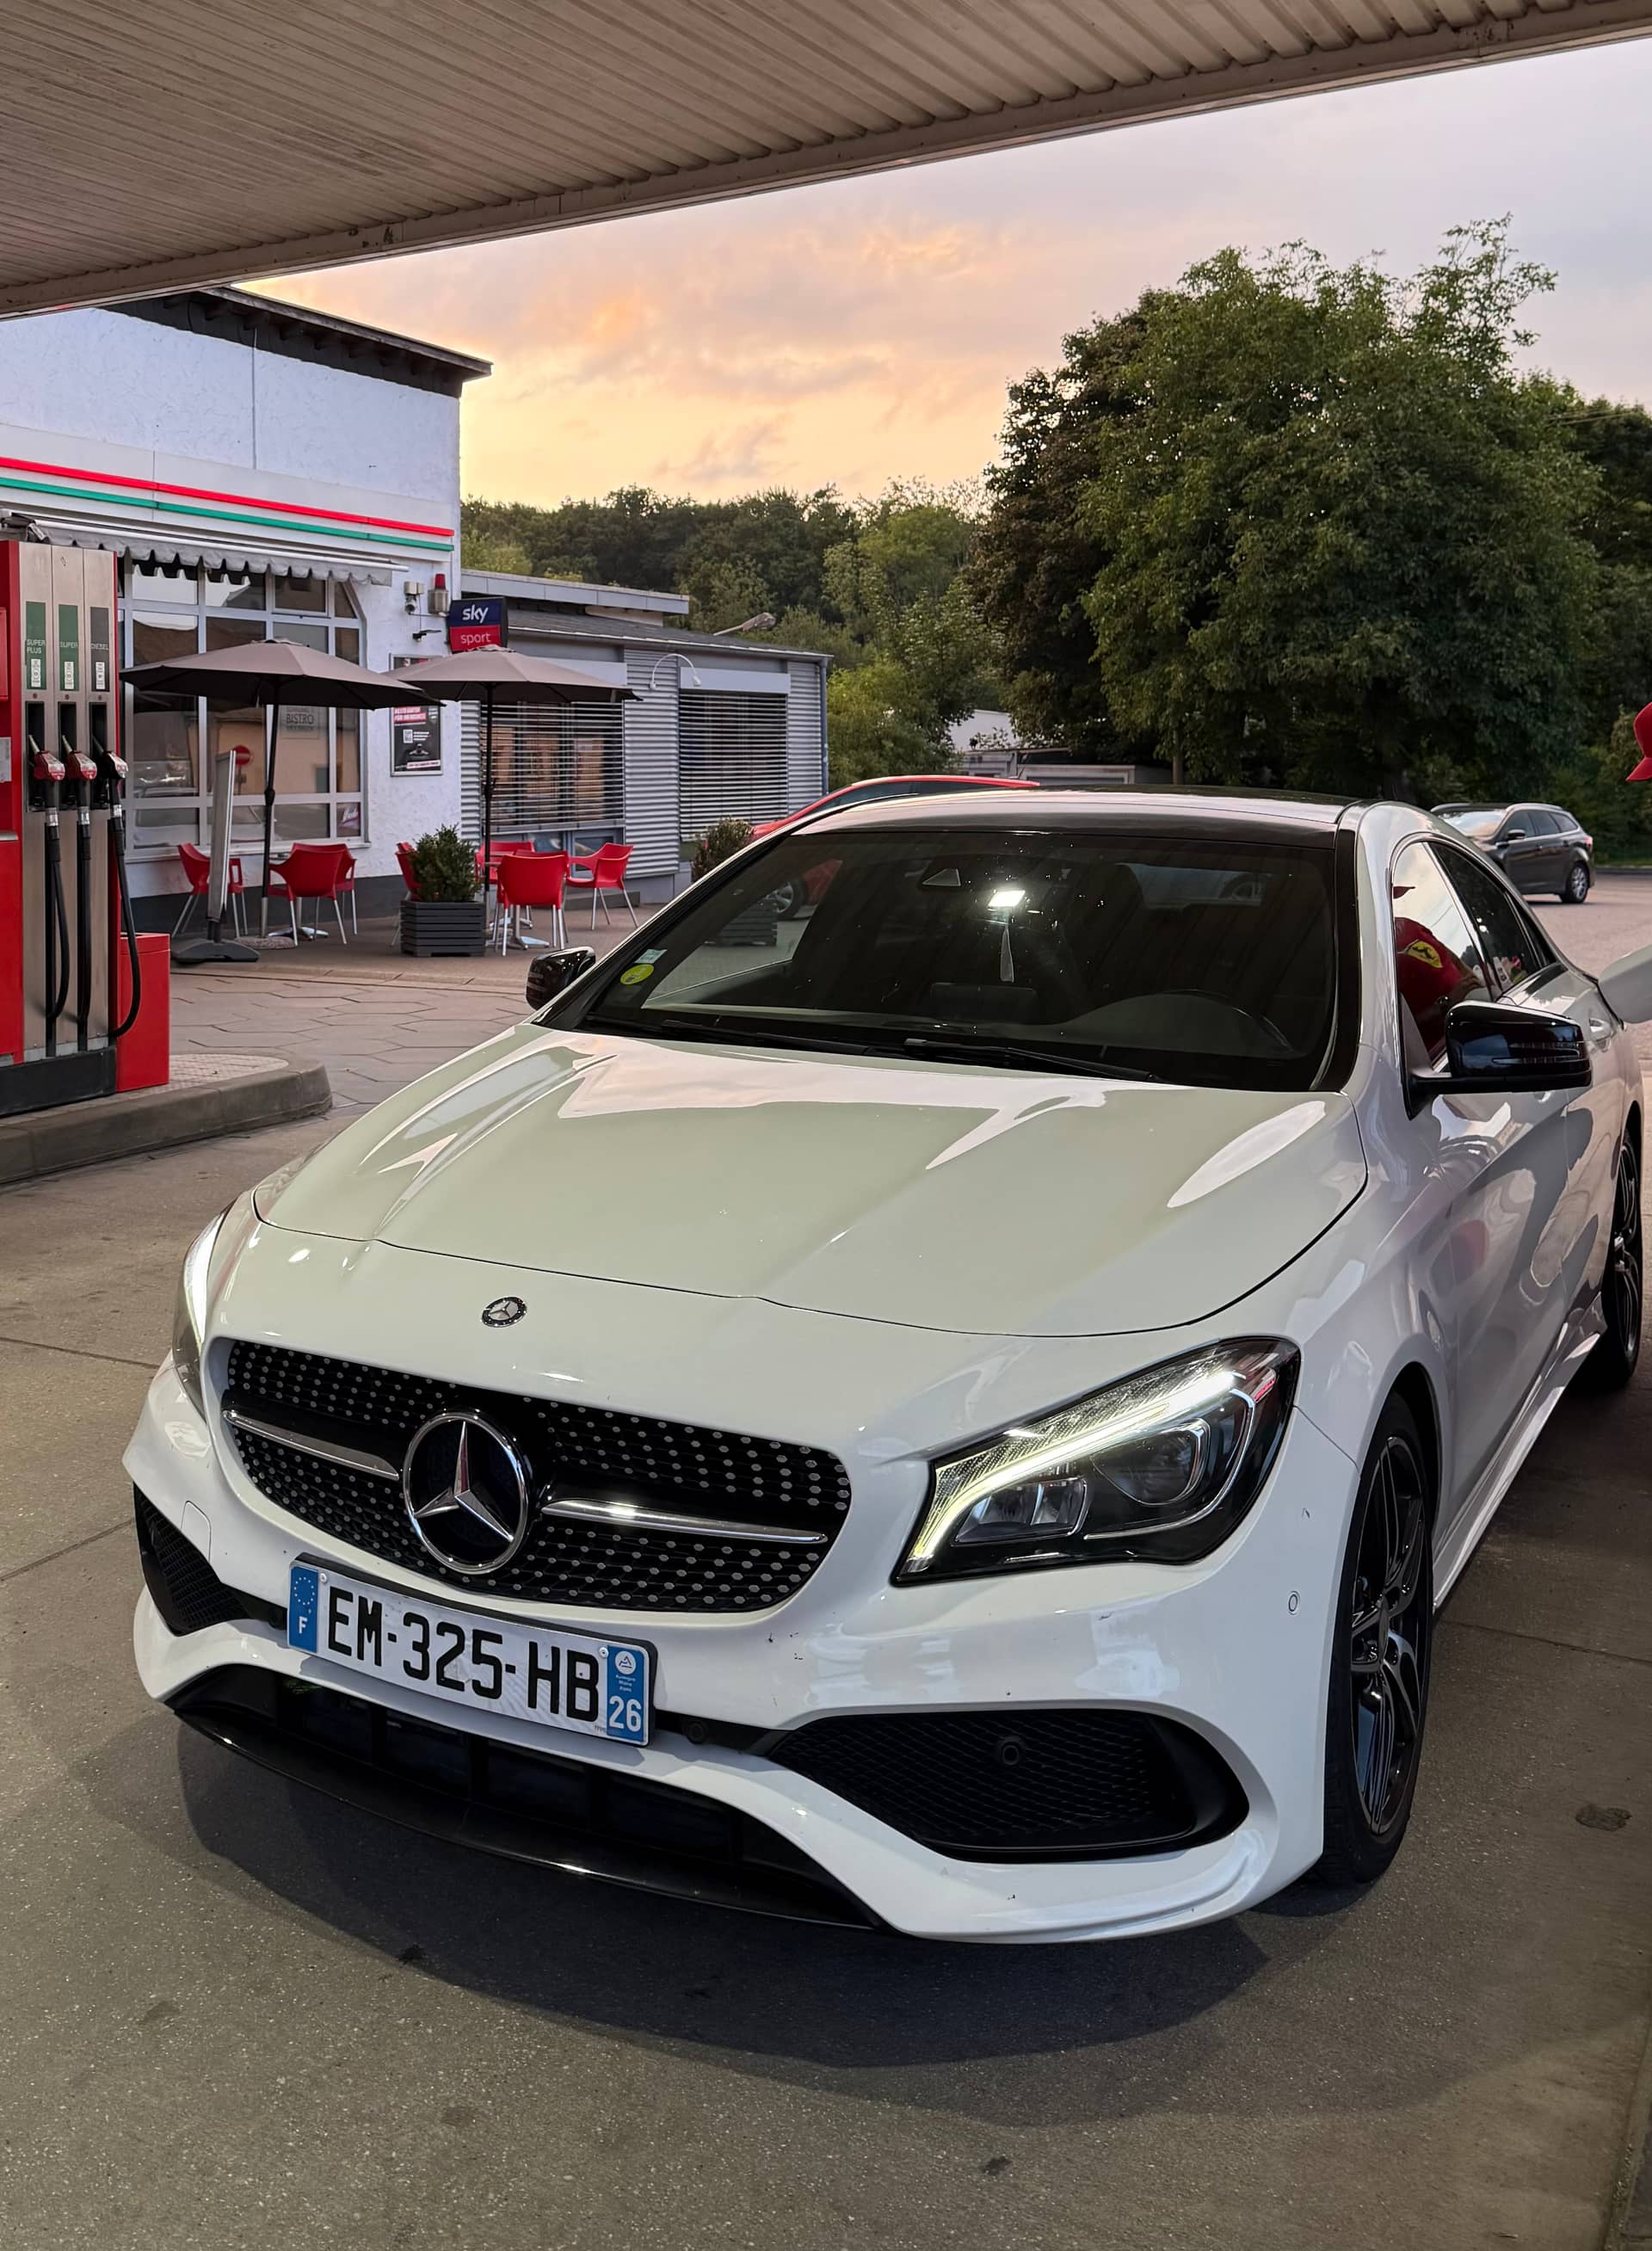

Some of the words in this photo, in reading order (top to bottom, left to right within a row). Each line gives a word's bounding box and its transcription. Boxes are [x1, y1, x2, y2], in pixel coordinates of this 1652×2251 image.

[462, 604, 489, 624] sky
[460, 632, 491, 645] sport
[286, 713, 315, 725] BISTRO
[298, 1615, 308, 1634] F
[328, 1586, 600, 1723] EM-325-HB
[608, 1695, 642, 1732] 26
